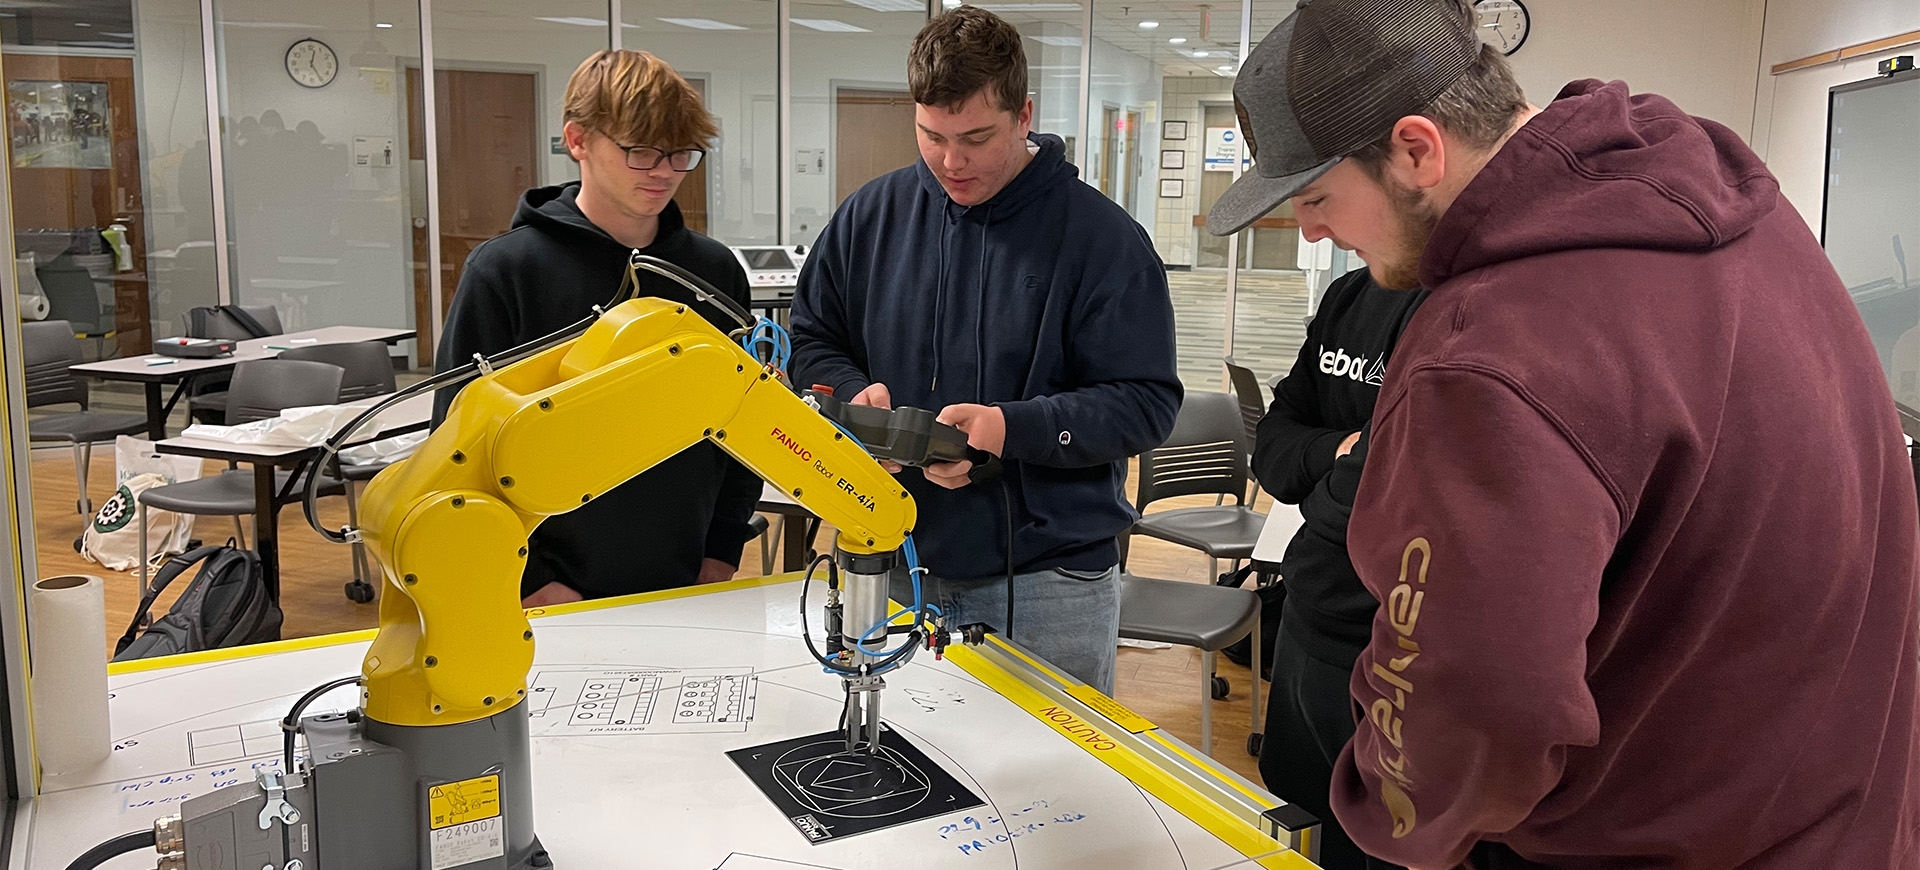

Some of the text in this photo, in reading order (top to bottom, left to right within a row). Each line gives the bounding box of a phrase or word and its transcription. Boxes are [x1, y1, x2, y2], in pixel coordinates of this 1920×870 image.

[770, 427, 876, 512] FANUC Robot ER-4iA
[1039, 706, 1116, 751] CAUTION
[436, 818, 497, 842] F249007
